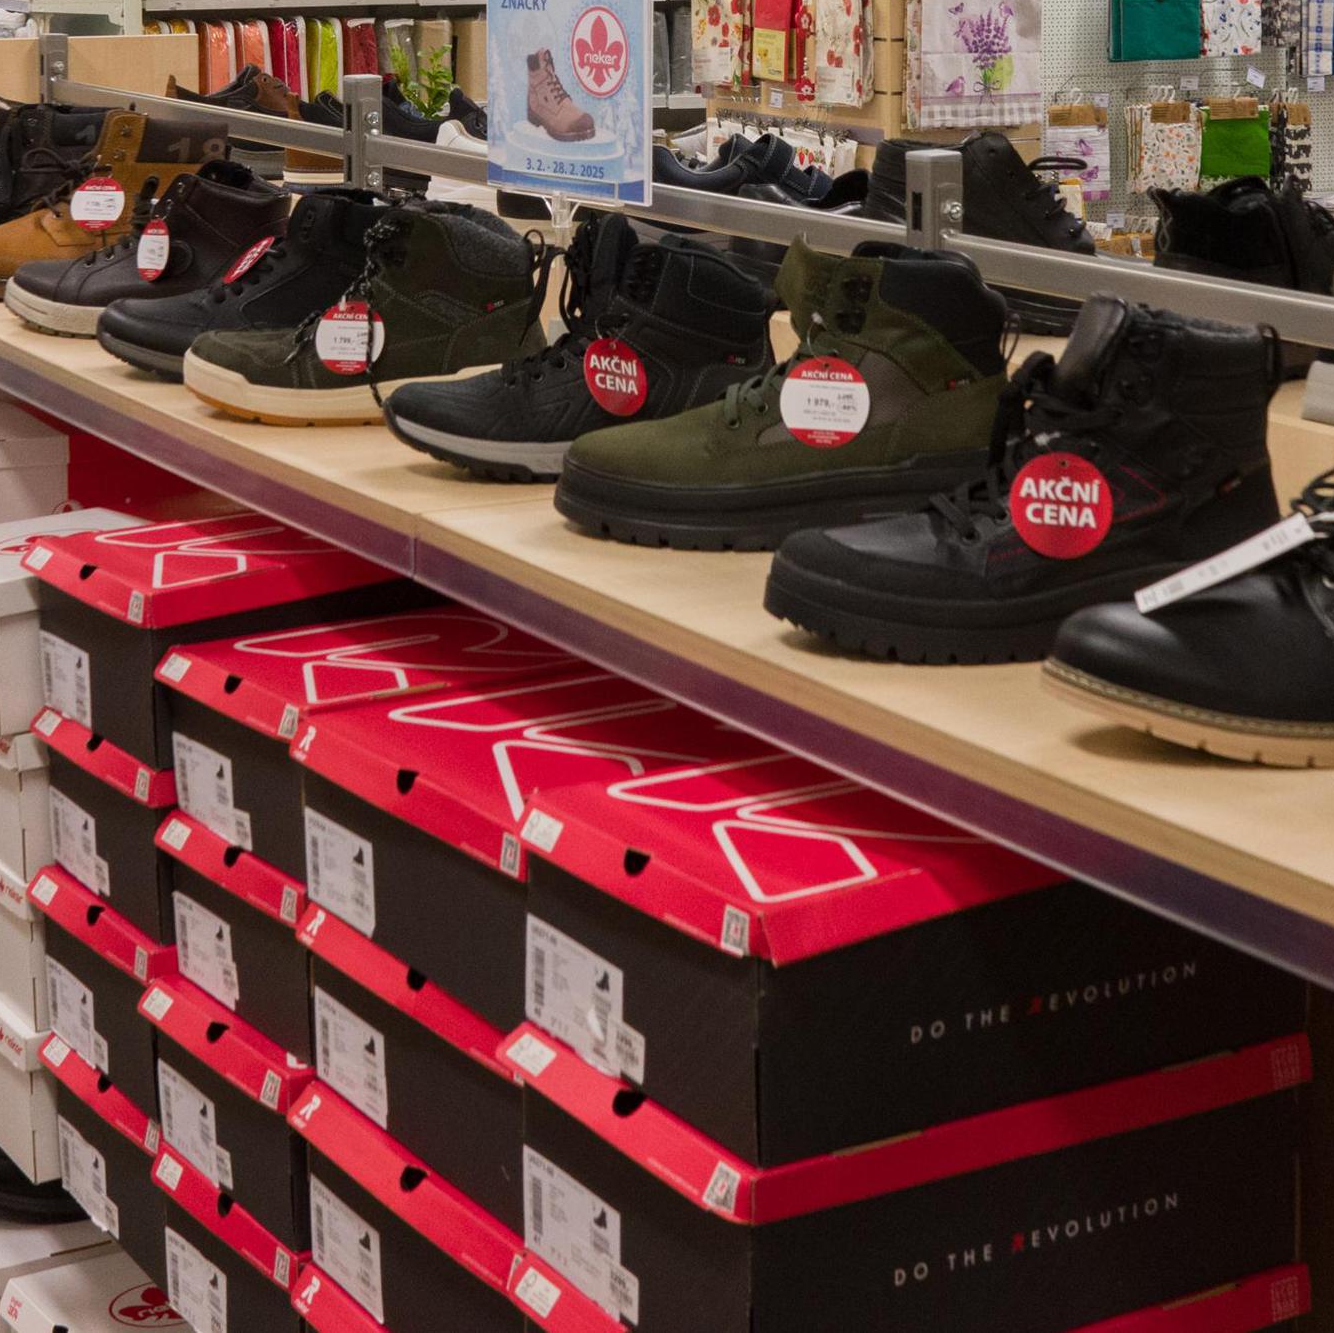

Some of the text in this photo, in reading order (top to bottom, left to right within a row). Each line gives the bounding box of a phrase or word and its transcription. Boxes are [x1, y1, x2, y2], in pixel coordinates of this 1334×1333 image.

[584, 50, 617, 65] rieker
[526, 158, 533, 170] 3.
[537, 160, 545, 171] 2.
[552, 162, 567, 174] 28.
[568, 163, 579, 175] 2.
[580, 165, 605, 179] 2025
[589, 353, 637, 376] AKČNÍ
[801, 370, 854, 380] AKČNÍ CENA
[595, 374, 639, 395] CENA
[1019, 476, 1101, 504] AKČNÍ
[1026, 502, 1097, 529] CENA
[911, 1020, 946, 1044] DO
[965, 1004, 1010, 1031] THE
[894, 1192, 1179, 1287] DO THE REVOLUTION
